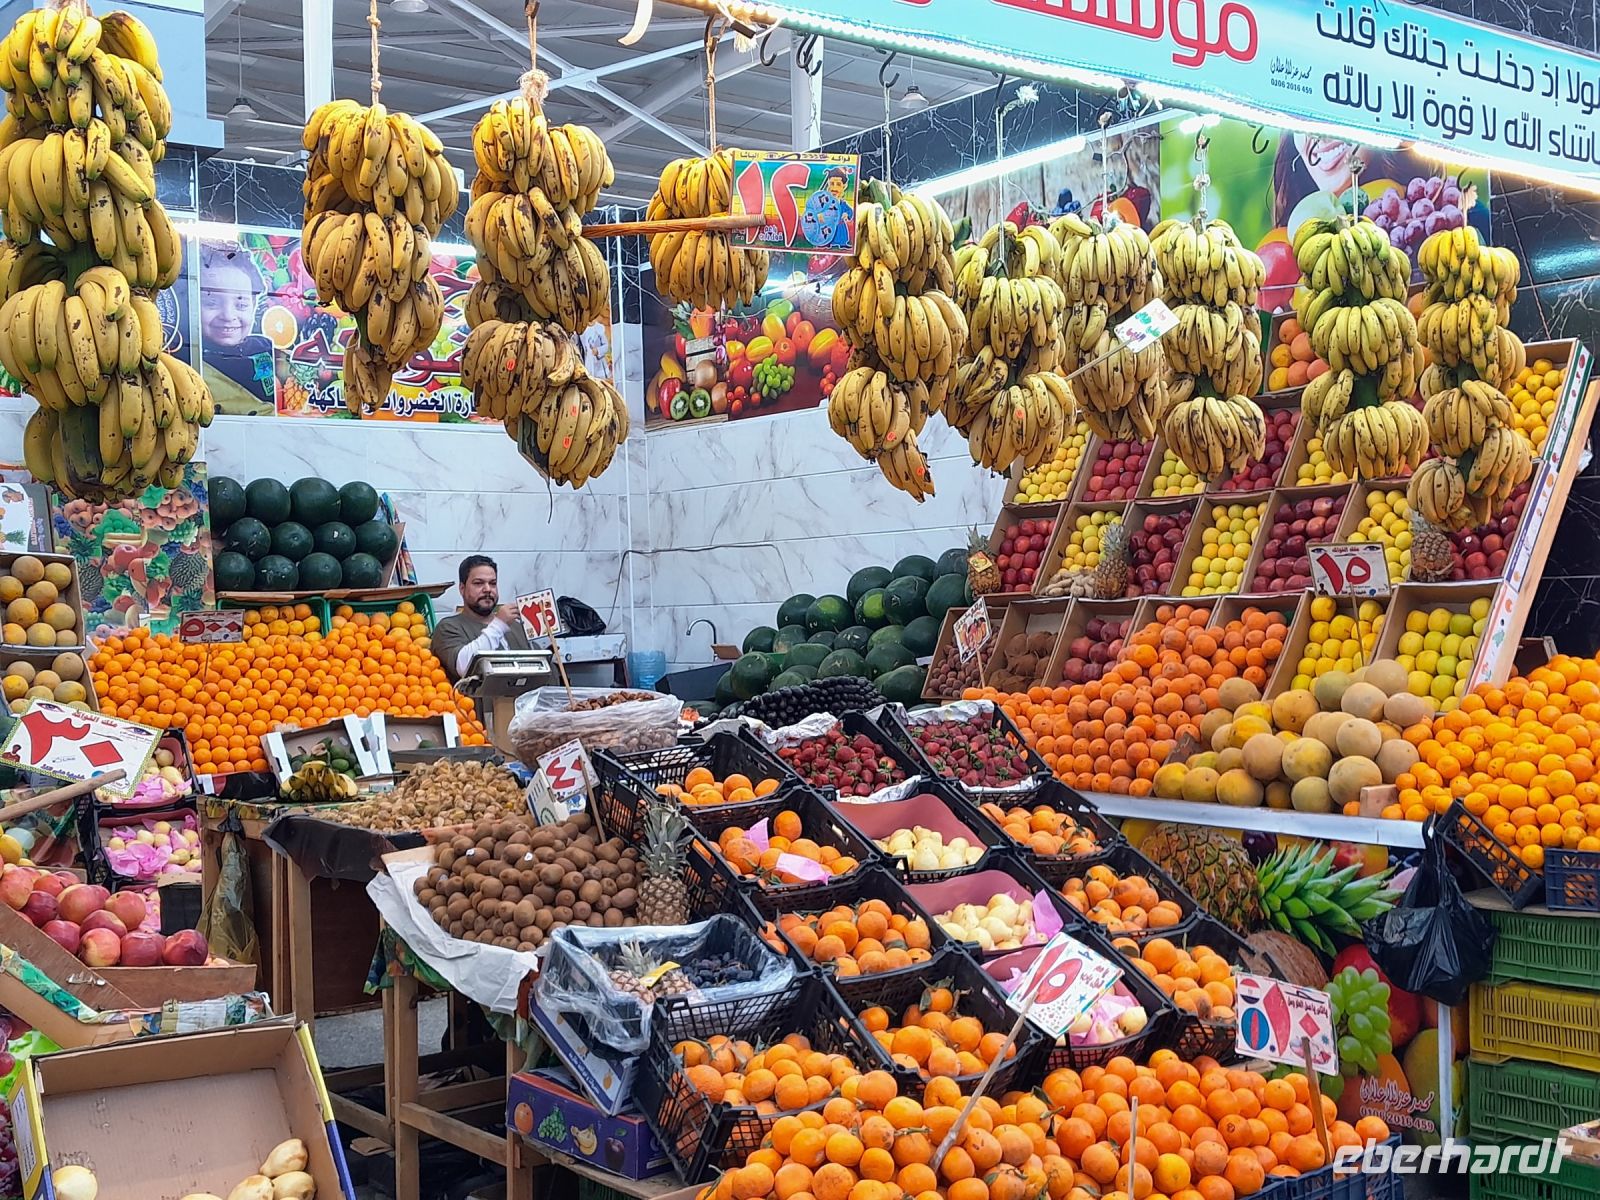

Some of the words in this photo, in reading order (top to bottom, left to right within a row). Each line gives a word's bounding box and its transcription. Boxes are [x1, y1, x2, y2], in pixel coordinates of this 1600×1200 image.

[1317, 1, 1376, 49] قلت
[1384, 22, 1448, 76] جنتك
[1301, 86, 1313, 95] 459
[1457, 41, 1534, 92] دخلت
[1542, 63, 1559, 107] إذ
[1323, 65, 1382, 122] بالله
[1392, 81, 1414, 129] إلا
[1423, 89, 1473, 139] قوة
[1482, 105, 1496, 141] لا
[1504, 112, 1541, 152] الله
[1316, 553, 1371, 595] ١٥
[1018, 941, 1083, 1005] ١٥
[1414, 1117, 1435, 1133] 459
